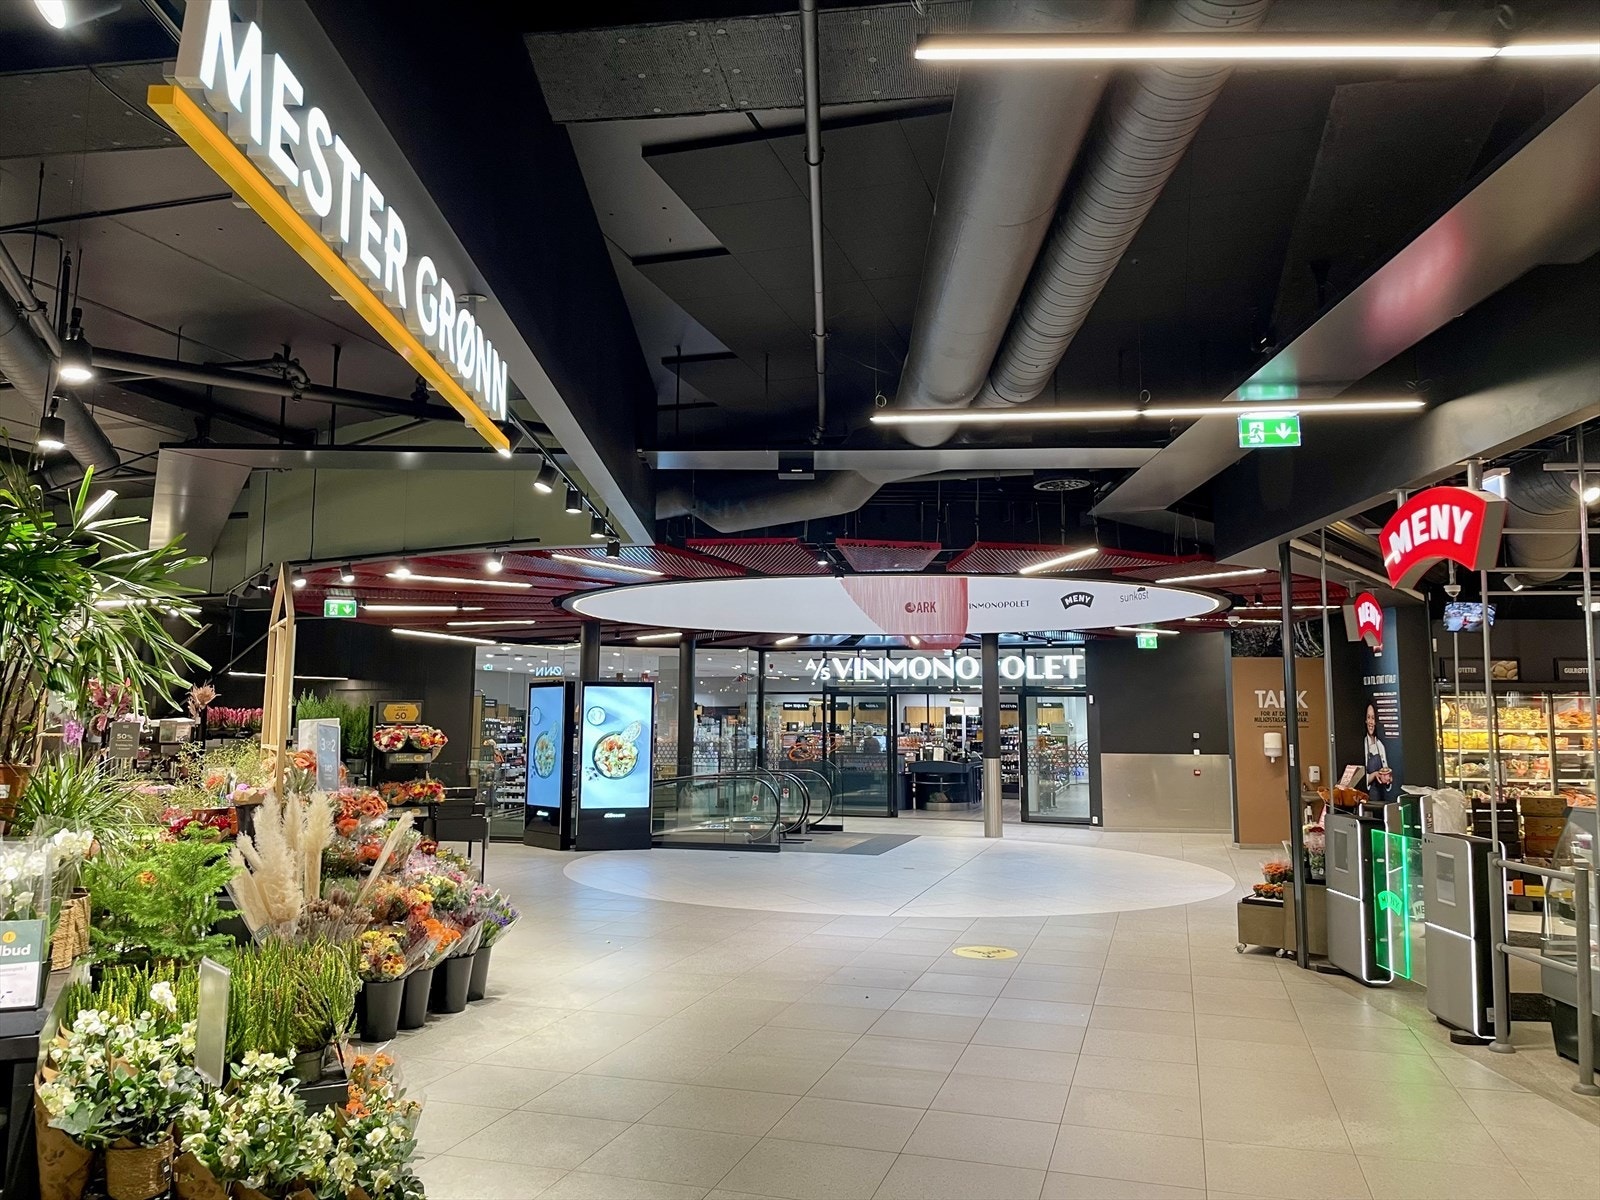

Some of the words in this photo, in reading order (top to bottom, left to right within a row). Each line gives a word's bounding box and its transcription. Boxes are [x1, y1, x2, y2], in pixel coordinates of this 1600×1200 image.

[200, 0, 408, 309] MESTER
[415, 255, 508, 422] GRØNN
[1388, 503, 1474, 565] MENY
[1064, 595, 1091, 606] MENY
[1119, 591, 1149, 603] sunkost
[916, 601, 937, 613] ARK
[969, 599, 1030, 610] INMONOPOLET
[805, 657, 831, 680] A/S
[832, 655, 1084, 680] VINMONOOLET
[394, 711, 407, 720] 60
